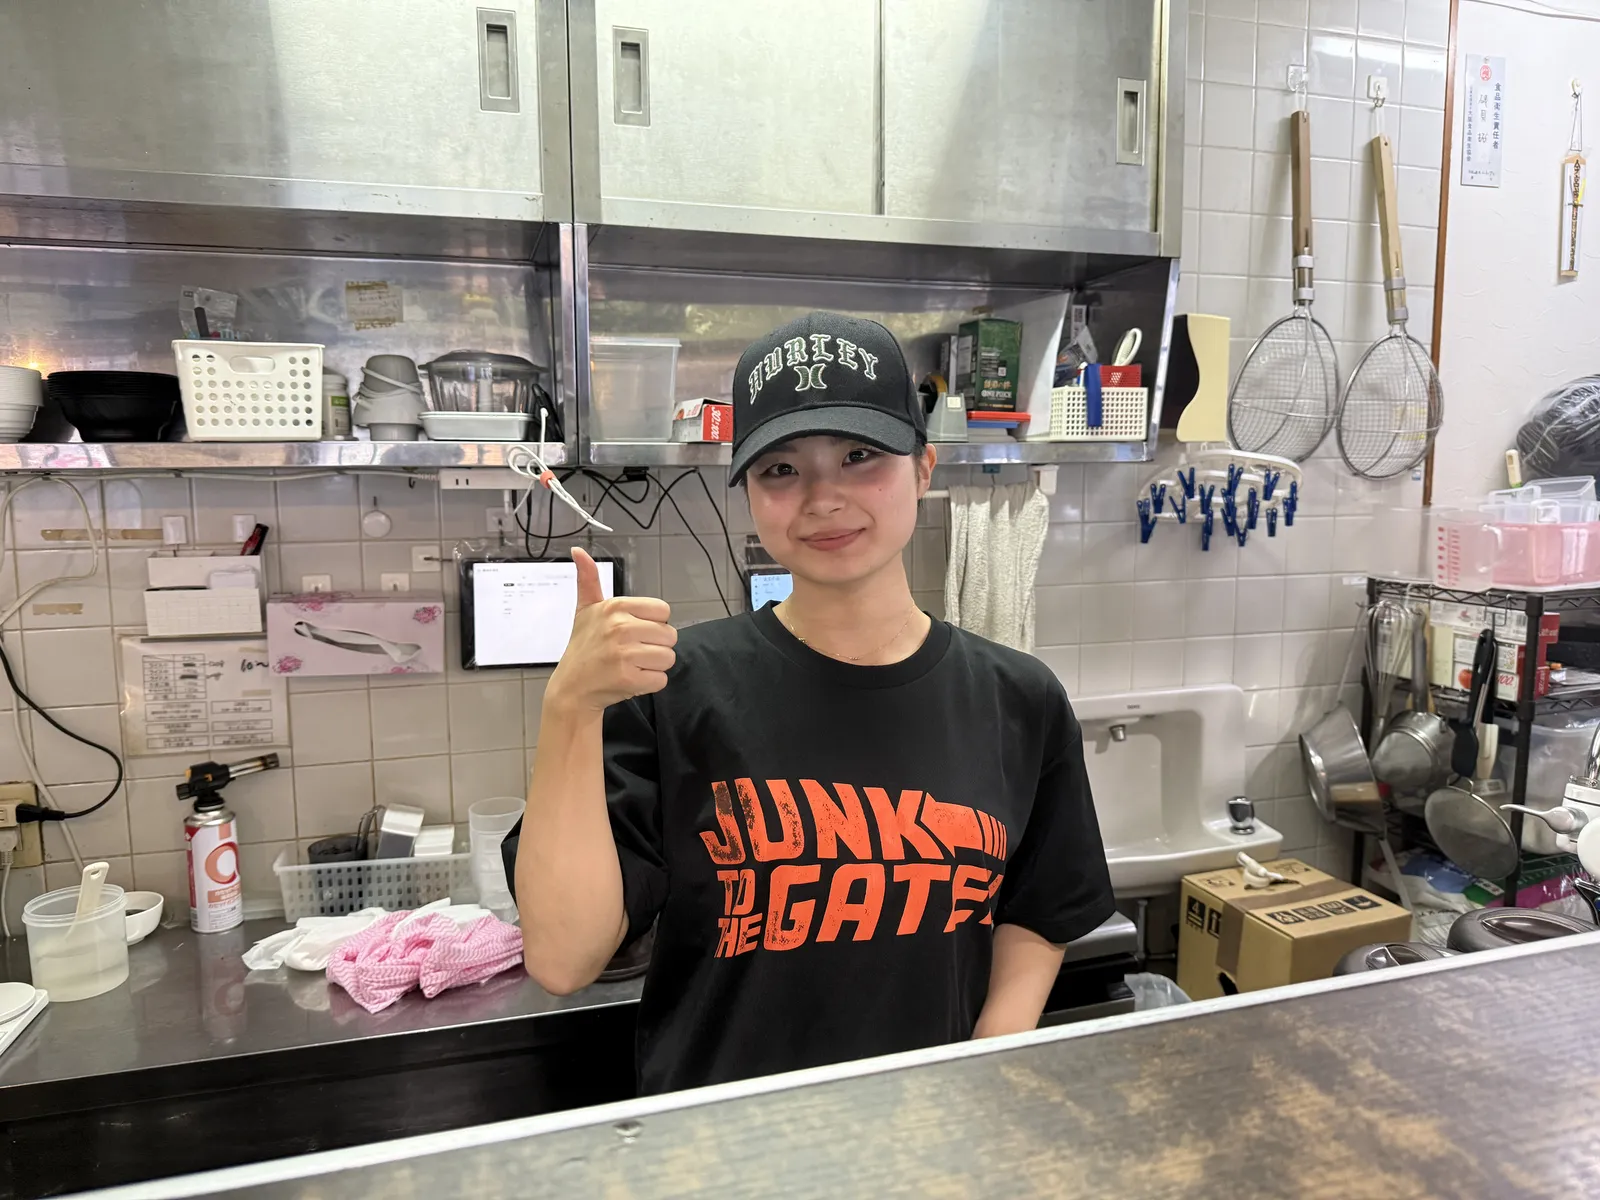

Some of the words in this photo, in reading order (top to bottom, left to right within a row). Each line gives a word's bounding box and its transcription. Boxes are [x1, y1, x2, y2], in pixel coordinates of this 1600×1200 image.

[1492, 82, 1502, 150] 食品衛生責任者
[748, 333, 879, 405] HURLEY
[699, 778, 944, 864] JUNK
[716, 869, 756, 916] TO
[714, 912, 763, 958] THE
